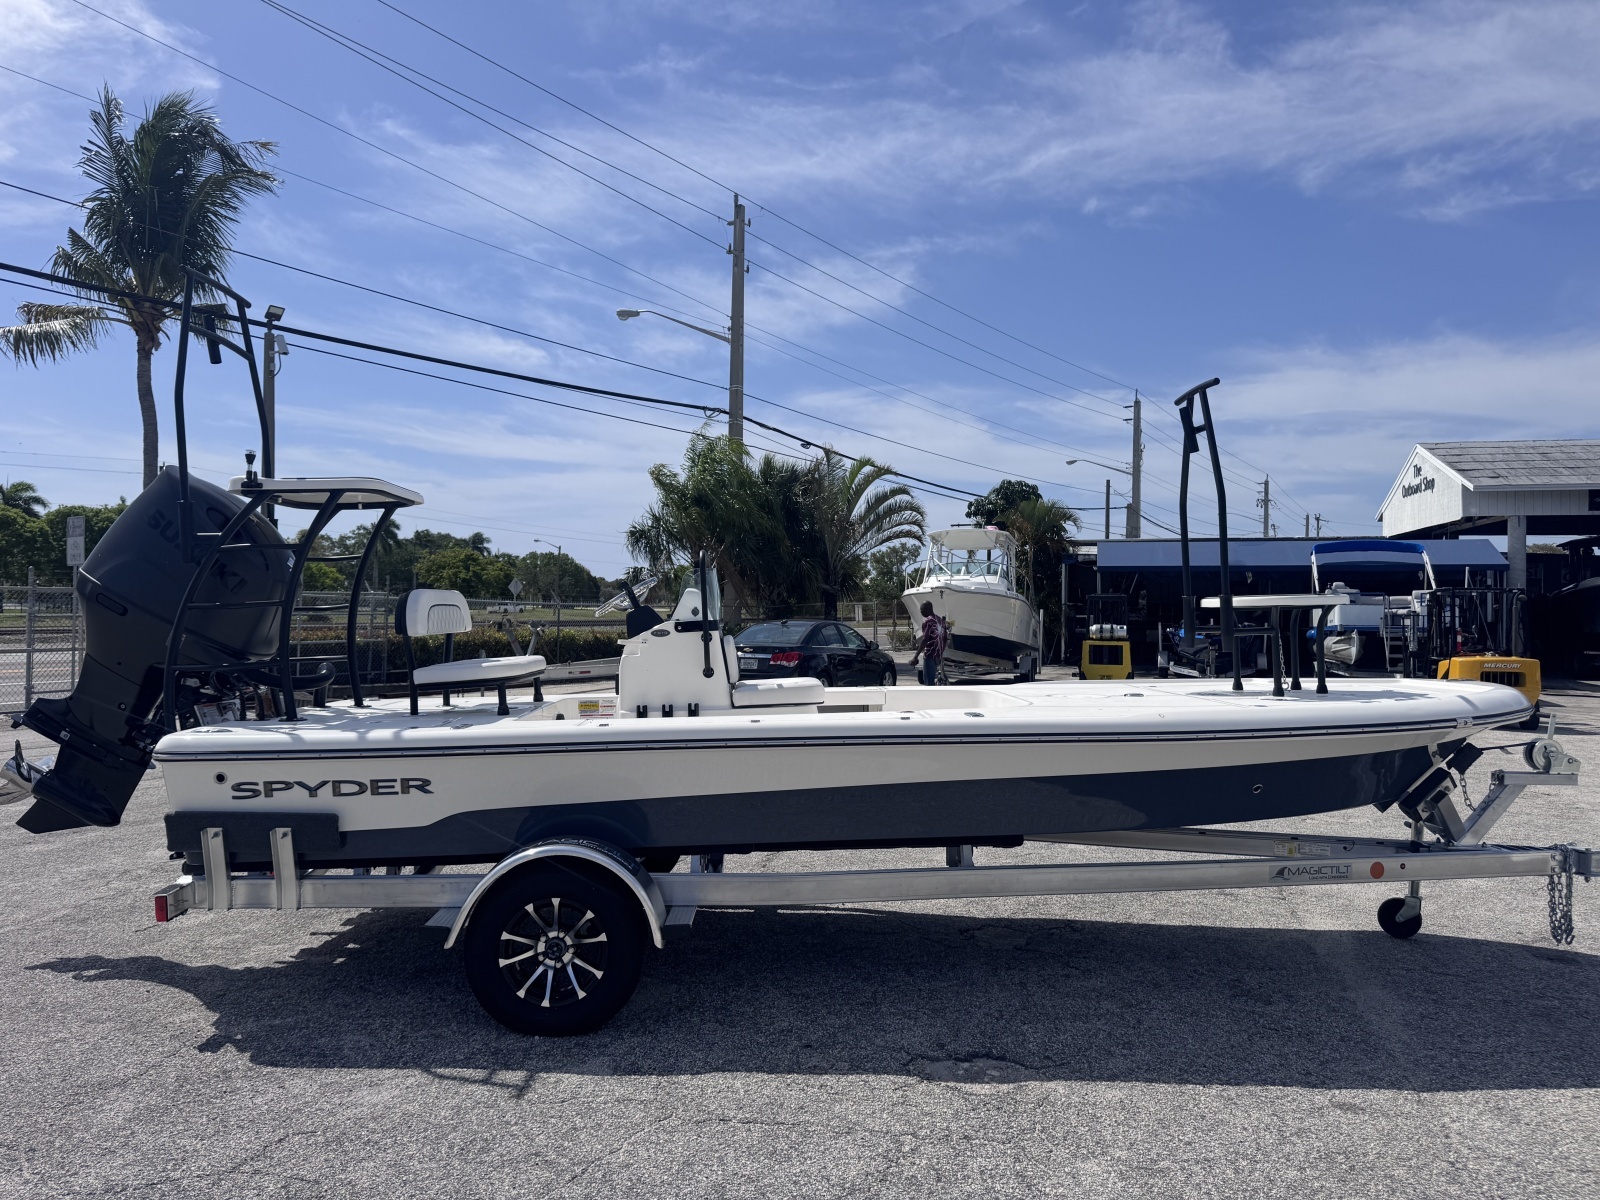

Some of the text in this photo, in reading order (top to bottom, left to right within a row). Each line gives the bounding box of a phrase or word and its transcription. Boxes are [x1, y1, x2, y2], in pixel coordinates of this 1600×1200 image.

[1413, 464, 1422, 478] The
[1402, 476, 1435, 498] Outboard Shop
[145, 509, 248, 594] SUKI
[231, 777, 434, 800] SPYDER
[1287, 865, 1352, 876] MAGICTILT
